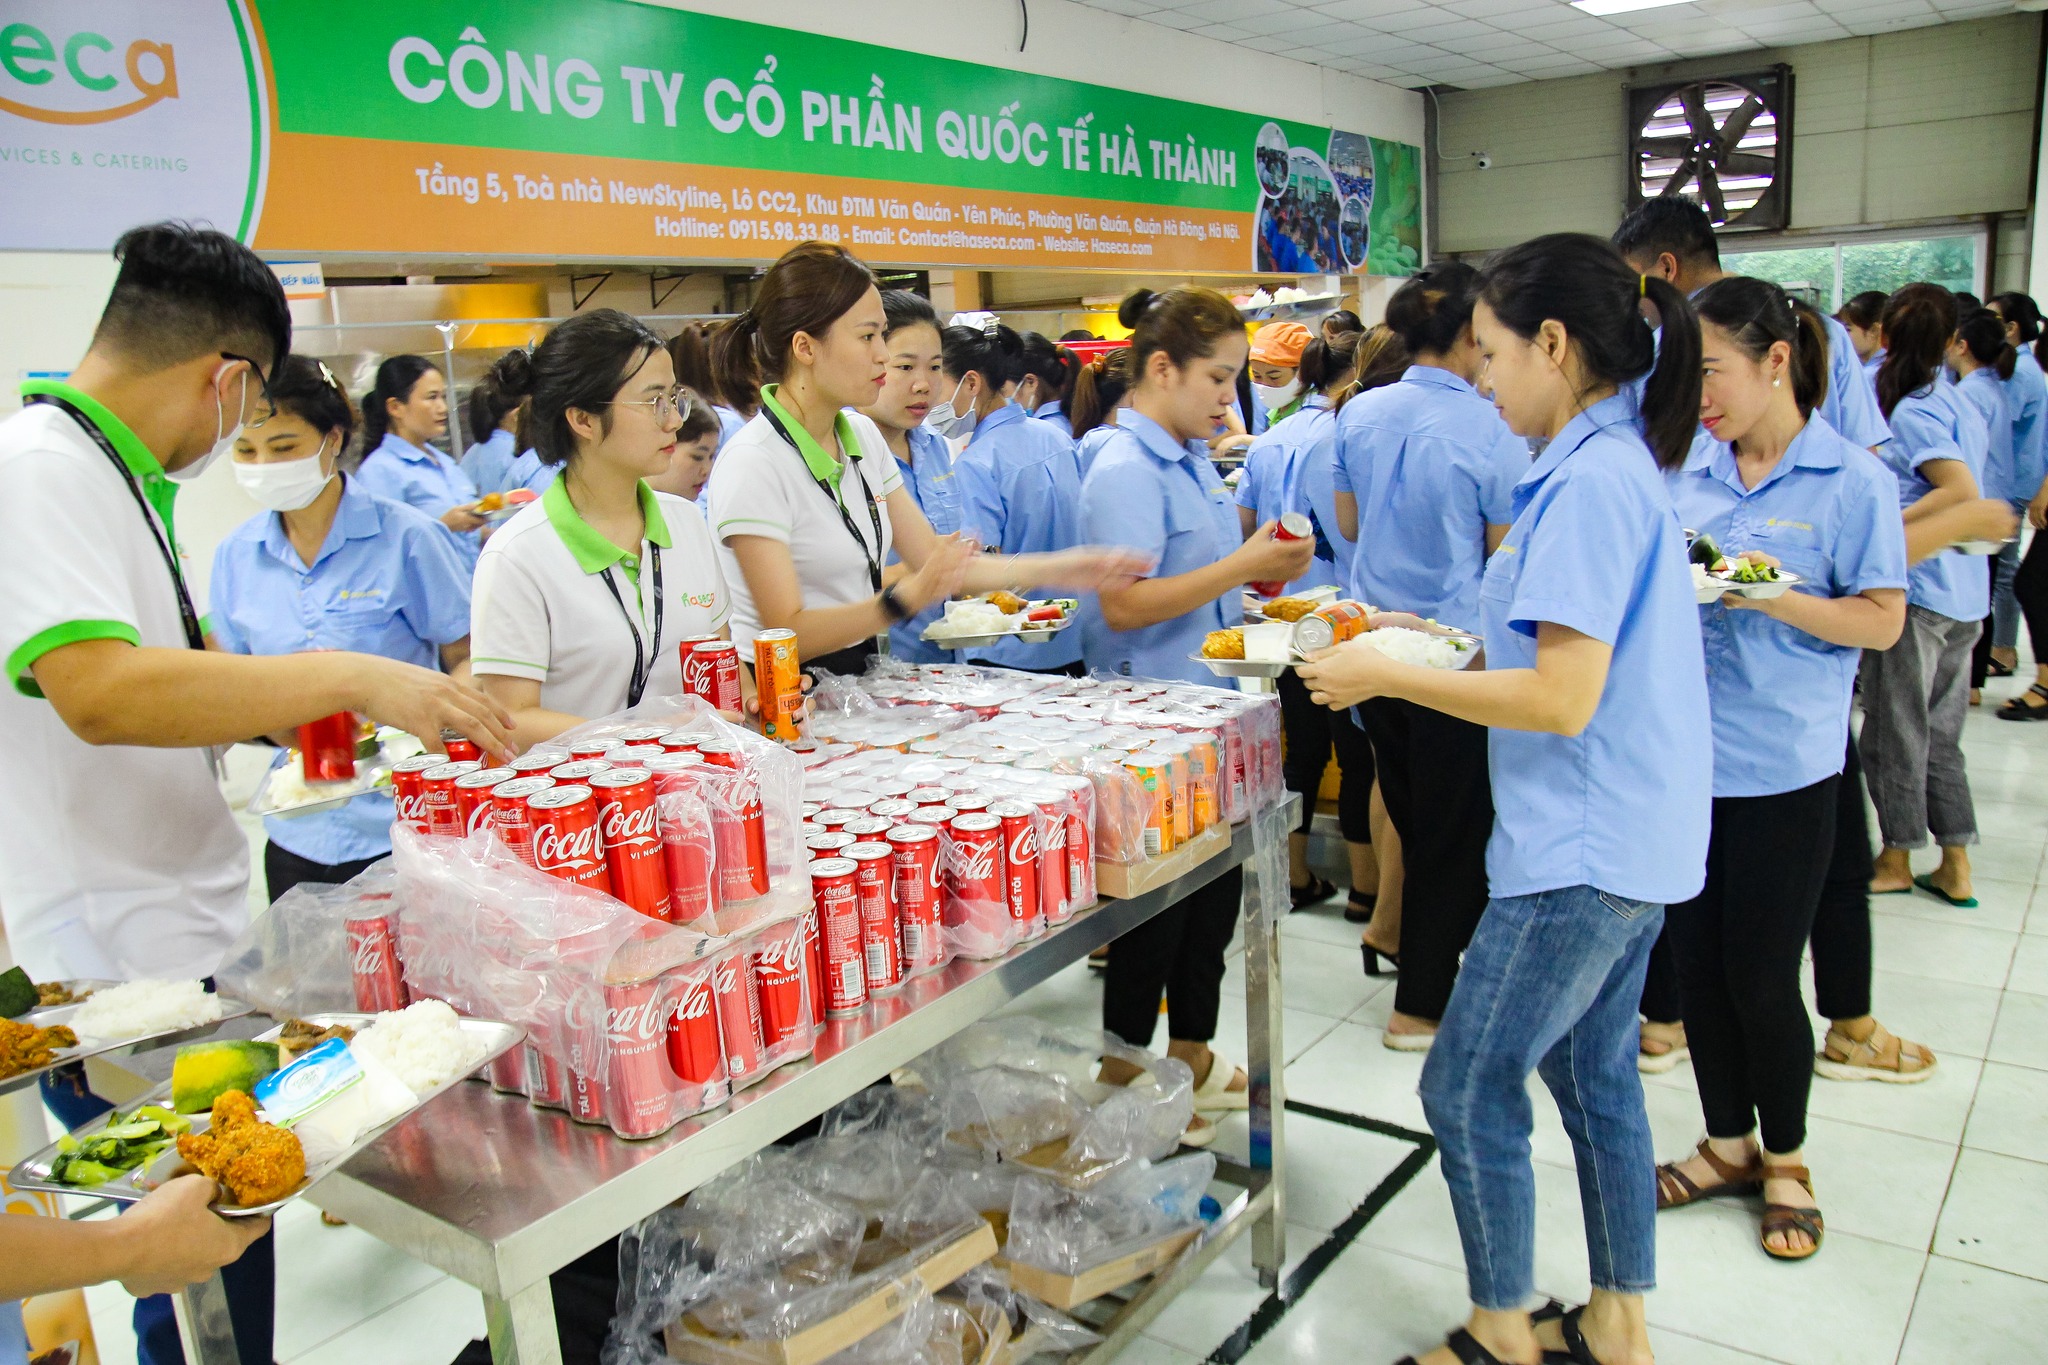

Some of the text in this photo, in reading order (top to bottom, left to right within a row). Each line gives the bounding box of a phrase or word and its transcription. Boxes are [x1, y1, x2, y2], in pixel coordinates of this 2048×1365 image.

[388, 26, 1237, 188] CÔNG TY CỔ PHẦN QUỐC TẾ HÀ THÀNH
[71, 151, 83, 166] &
[93, 152, 189, 173] CATERING
[415, 161, 480, 205] Tầng
[486, 173, 508, 202] 5,
[513, 174, 554, 201] Toà
[561, 177, 604, 203] nhà
[609, 181, 727, 213] NewSkyline,
[732, 187, 753, 211] Lô
[758, 190, 802, 217] CC2,
[806, 193, 838, 216] Khu
[842, 196, 875, 218] ĐTM
[878, 199, 909, 220] Văn
[912, 201, 951, 222] Quán
[962, 204, 987, 224] Yên
[990, 206, 1025, 230] Phúc,
[1028, 209, 1072, 234] Phường
[1075, 213, 1098, 232] Văn
[1100, 214, 1132, 236] Quán,
[1135, 217, 1161, 239] Quận
[1163, 218, 1178, 236] Hà
[1180, 220, 1207, 241] Đông,
[1208, 222, 1222, 238] Hà
[654, 216, 724, 239] Hotline:
[728, 219, 840, 242] 0915.98.33.88
[853, 225, 895, 245] Email:
[898, 227, 1035, 250] Contact@haseca.com
[1043, 235, 1088, 253] Website:
[1091, 238, 1152, 255] Haseca.com
